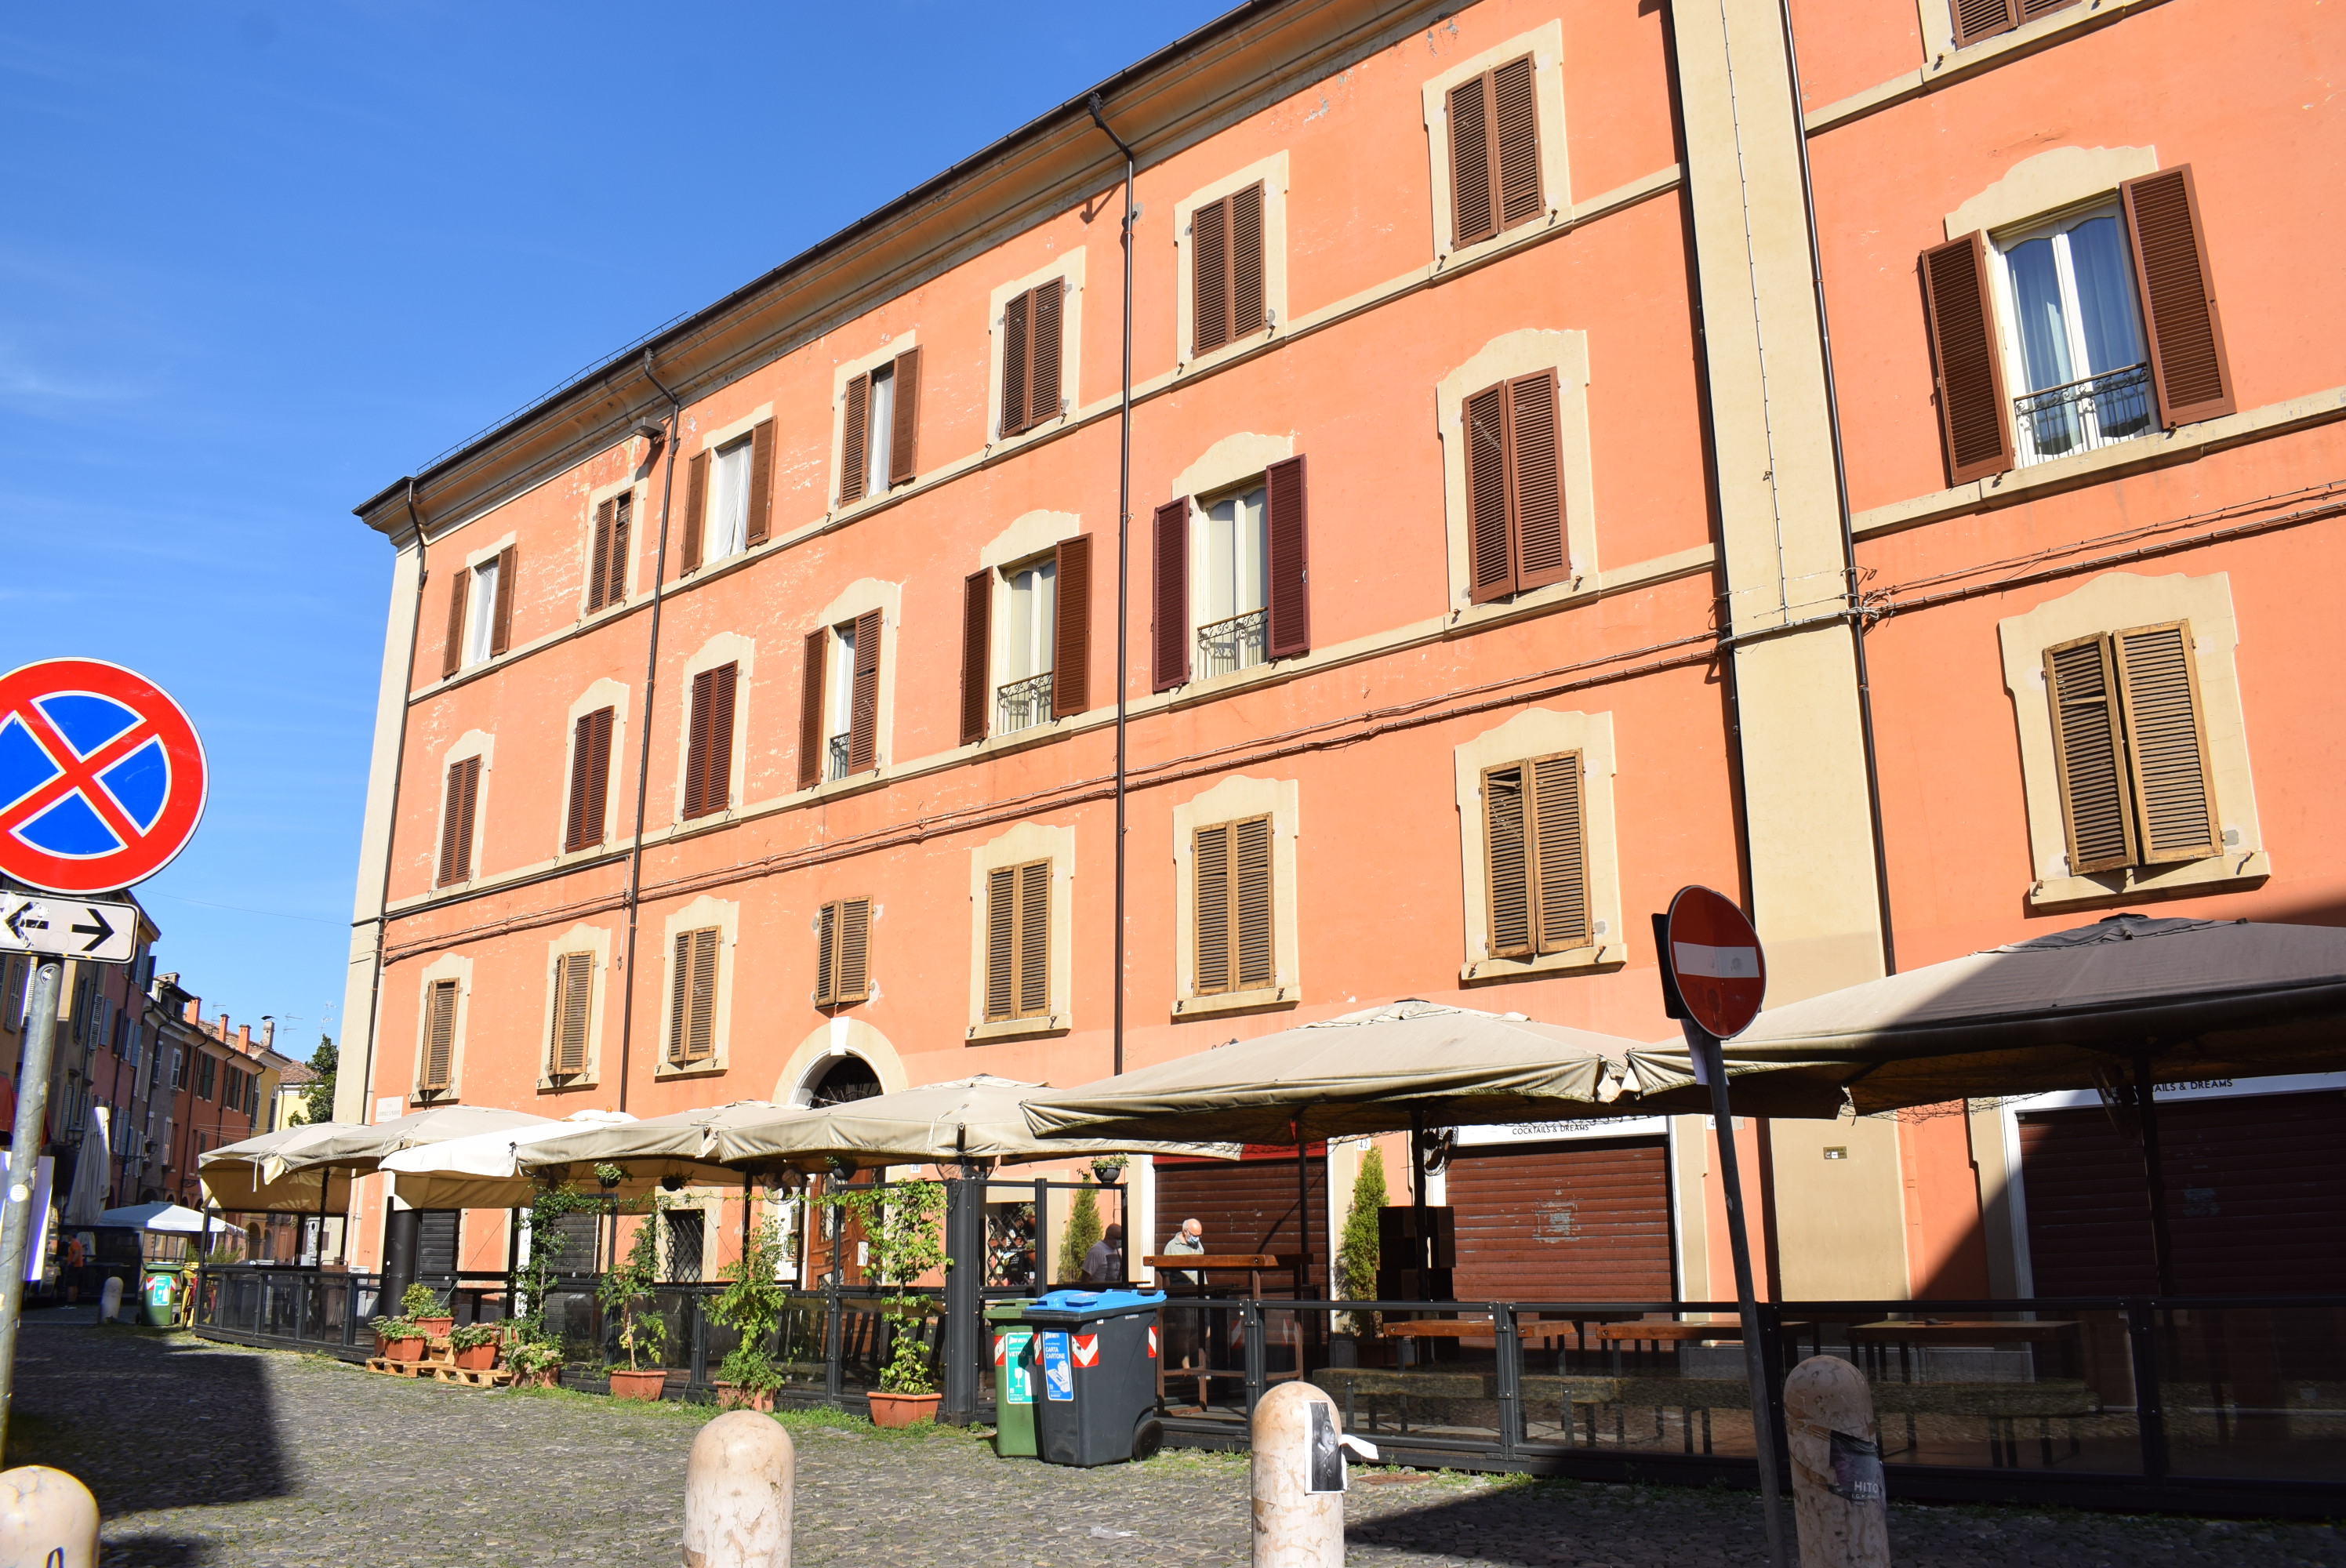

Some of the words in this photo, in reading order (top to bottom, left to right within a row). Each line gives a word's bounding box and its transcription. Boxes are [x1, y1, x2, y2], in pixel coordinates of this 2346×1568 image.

[2179, 1082, 2186, 1091] &
[2191, 1079, 2233, 1090] DREAMS
[1512, 1127, 1551, 1135] COCKTAILS
